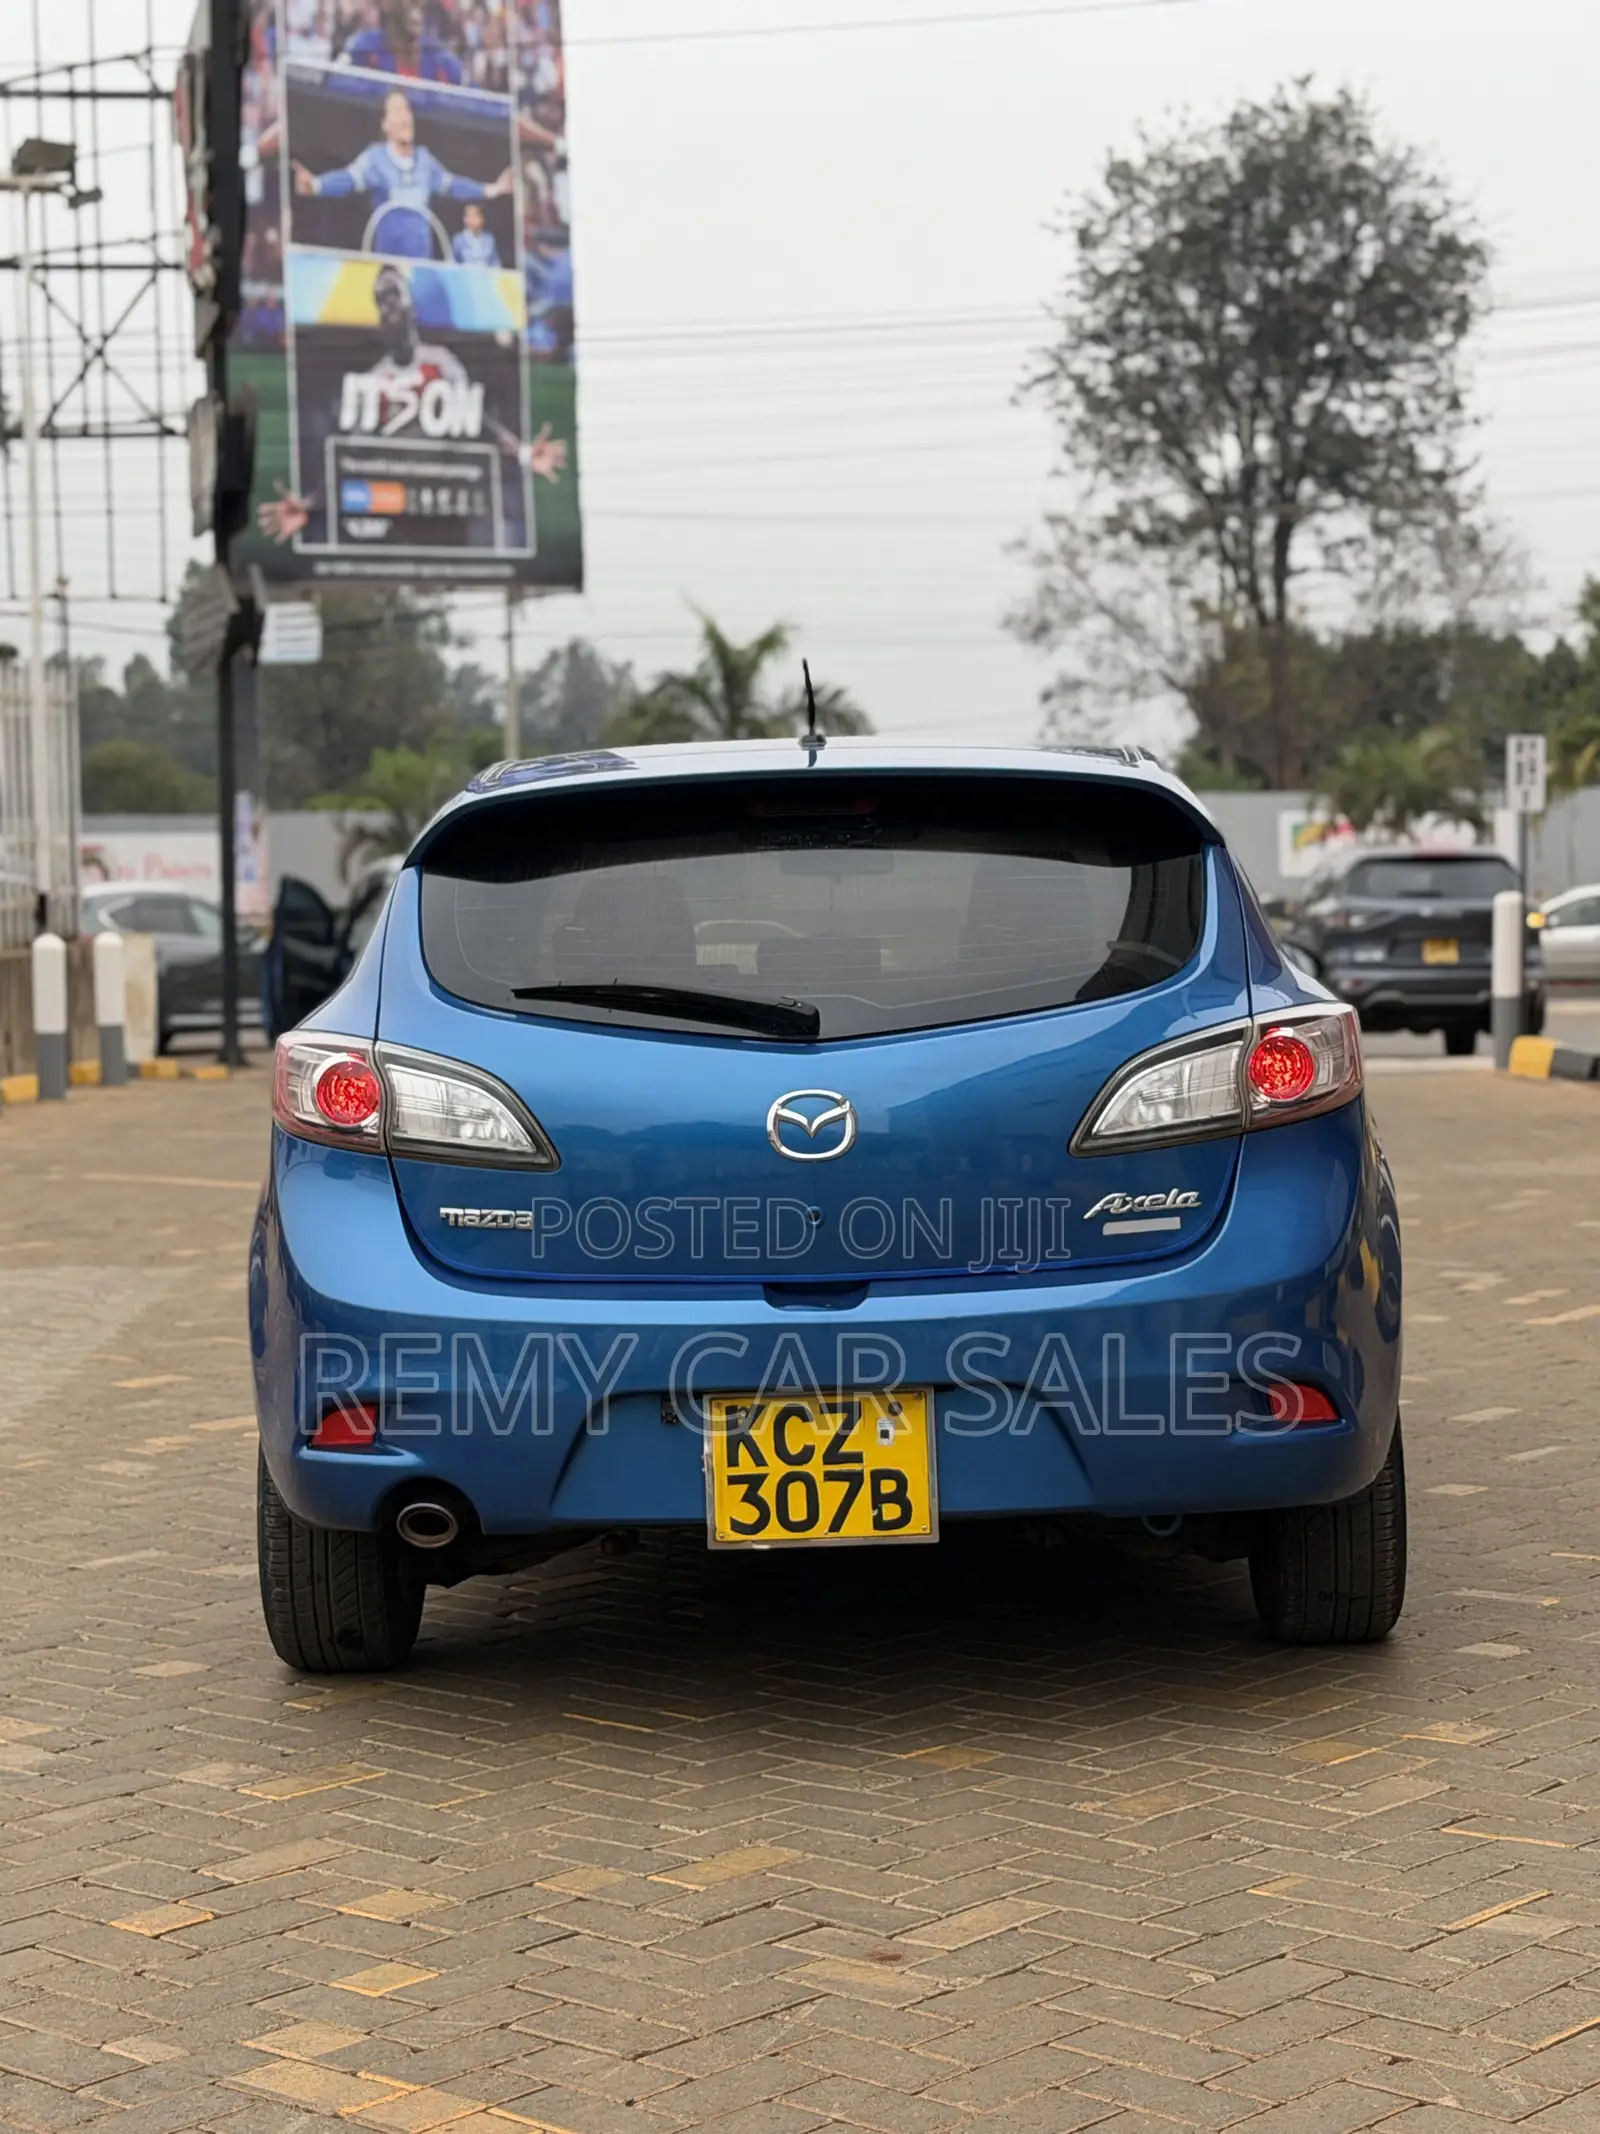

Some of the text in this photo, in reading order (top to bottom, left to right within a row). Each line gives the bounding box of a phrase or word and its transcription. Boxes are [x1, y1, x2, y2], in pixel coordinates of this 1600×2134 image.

[1083, 1188, 1202, 1219] Axela
[725, 1401, 864, 1468] KCZ
[727, 1468, 913, 1536] 307B
